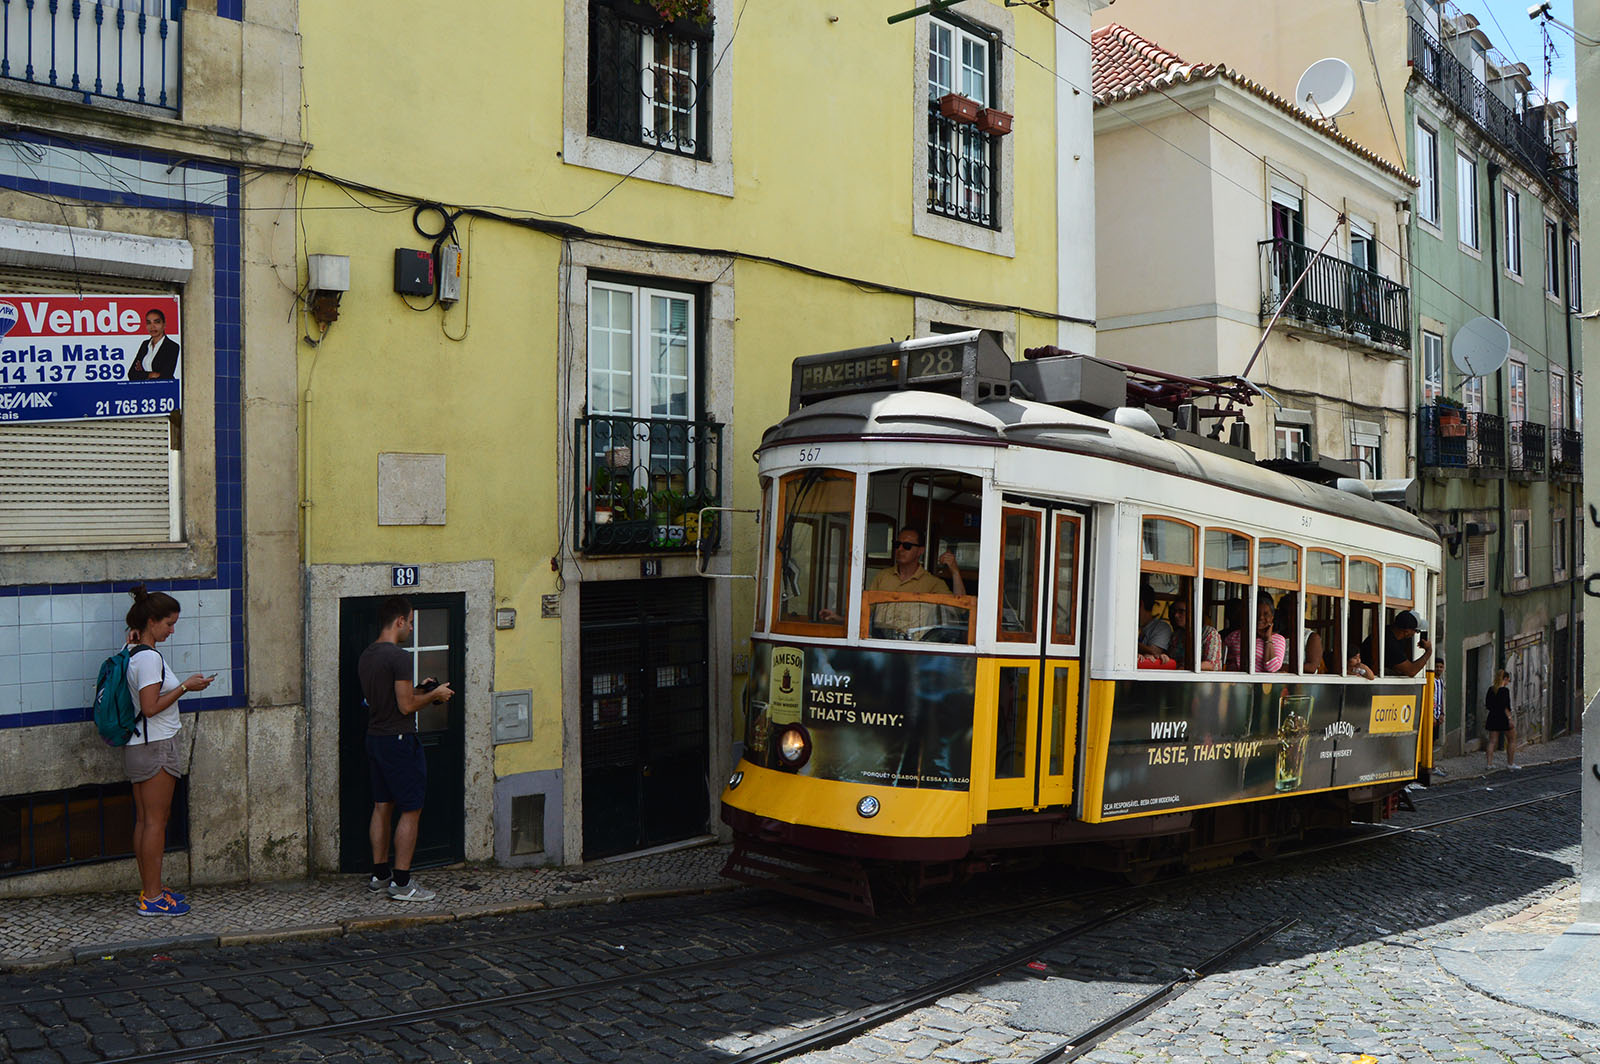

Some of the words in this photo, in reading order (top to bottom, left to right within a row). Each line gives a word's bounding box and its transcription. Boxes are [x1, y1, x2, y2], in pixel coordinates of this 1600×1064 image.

[21, 302, 141, 334] Vende
[1, 345, 53, 364] arla
[62, 344, 125, 362] Mata
[920, 348, 954, 376] 28
[0, 366, 27, 383] 14
[36, 365, 77, 382] 137
[85, 364, 125, 381] 589
[803, 357, 888, 385] PRAZERES
[0, 410, 19, 420] ais
[95, 400, 110, 415] 21
[115, 399, 138, 415] 765
[141, 398, 156, 413] 33
[160, 397, 174, 412] 50
[799, 447, 821, 462] 567
[1301, 514, 1312, 528] 567
[396, 567, 415, 586] 89
[646, 559, 657, 576] 91
[811, 672, 851, 688] WHY?
[810, 689, 857, 708] TASTE,
[809, 706, 857, 723] THAT'S
[1374, 703, 1398, 722] carris
[1150, 720, 1188, 740] WHY?
[1323, 721, 1356, 741] JAMESON
[1147, 745, 1189, 766] TASTE,
[1192, 742, 1232, 762] THAT'S
[1319, 750, 1333, 759] IRISH
[1333, 748, 1353, 758] WHISKEY
[926, 775, 942, 783] ESSA
